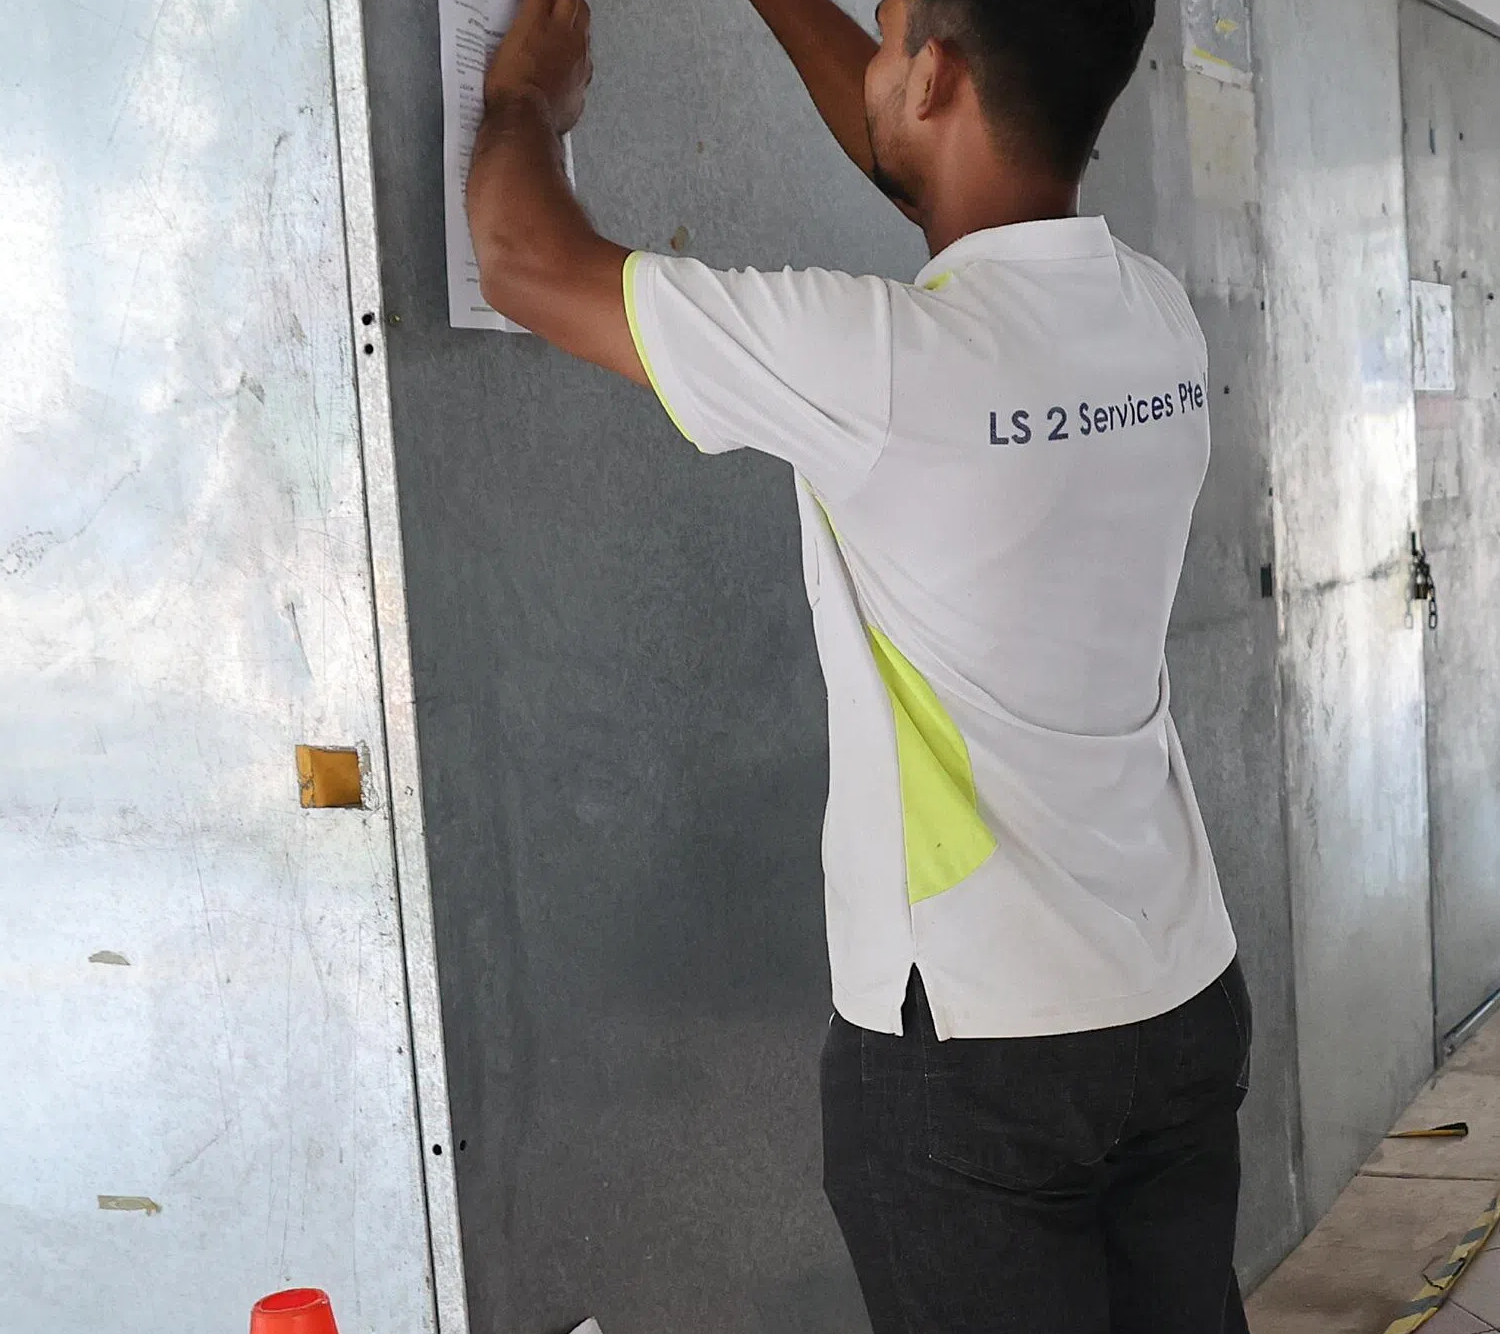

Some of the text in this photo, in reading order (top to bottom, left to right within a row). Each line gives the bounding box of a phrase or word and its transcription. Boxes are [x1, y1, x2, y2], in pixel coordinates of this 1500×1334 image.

[989, 410, 1032, 446] LS
[1047, 406, 1069, 442] 2
[1078, 392, 1175, 436] Services
[1178, 379, 1204, 414] Pte
